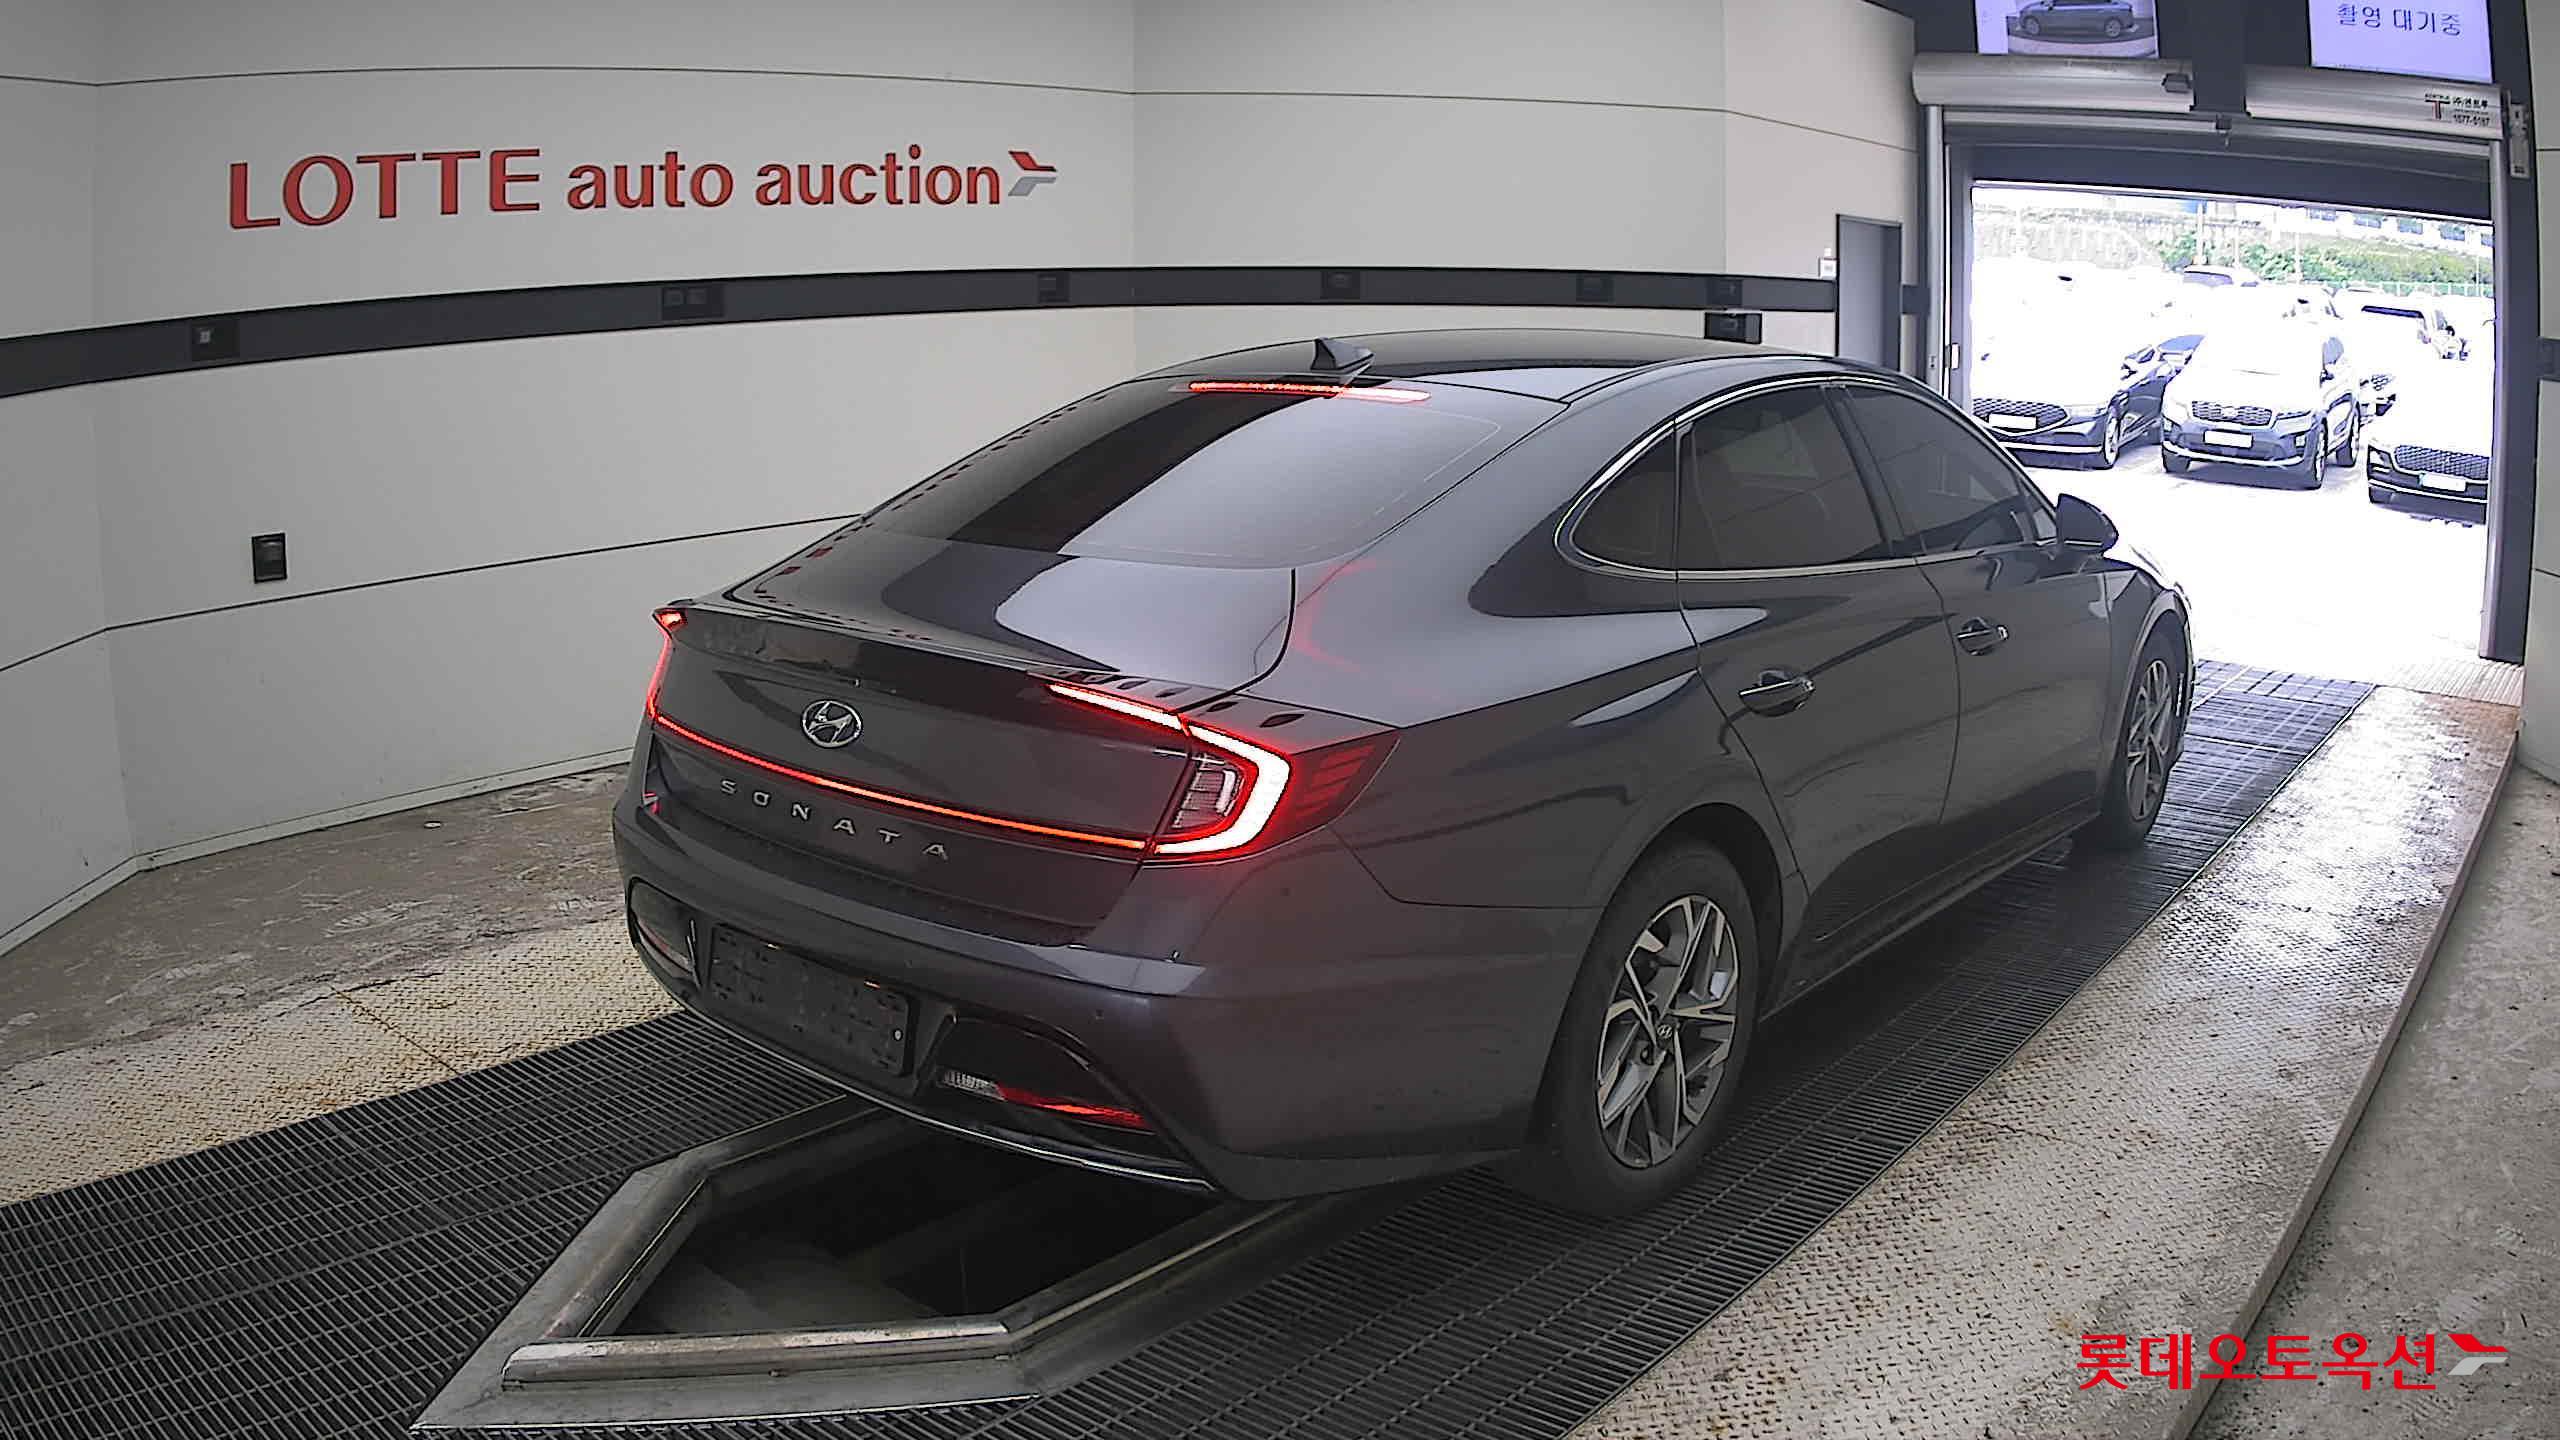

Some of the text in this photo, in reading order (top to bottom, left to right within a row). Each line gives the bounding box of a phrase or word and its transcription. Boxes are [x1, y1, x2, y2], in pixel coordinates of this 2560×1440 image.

[2337, 4, 2461, 36] 촬영 대기중
[229, 144, 1001, 229] LOTTE auto auction
[720, 779, 949, 860] SONATA
